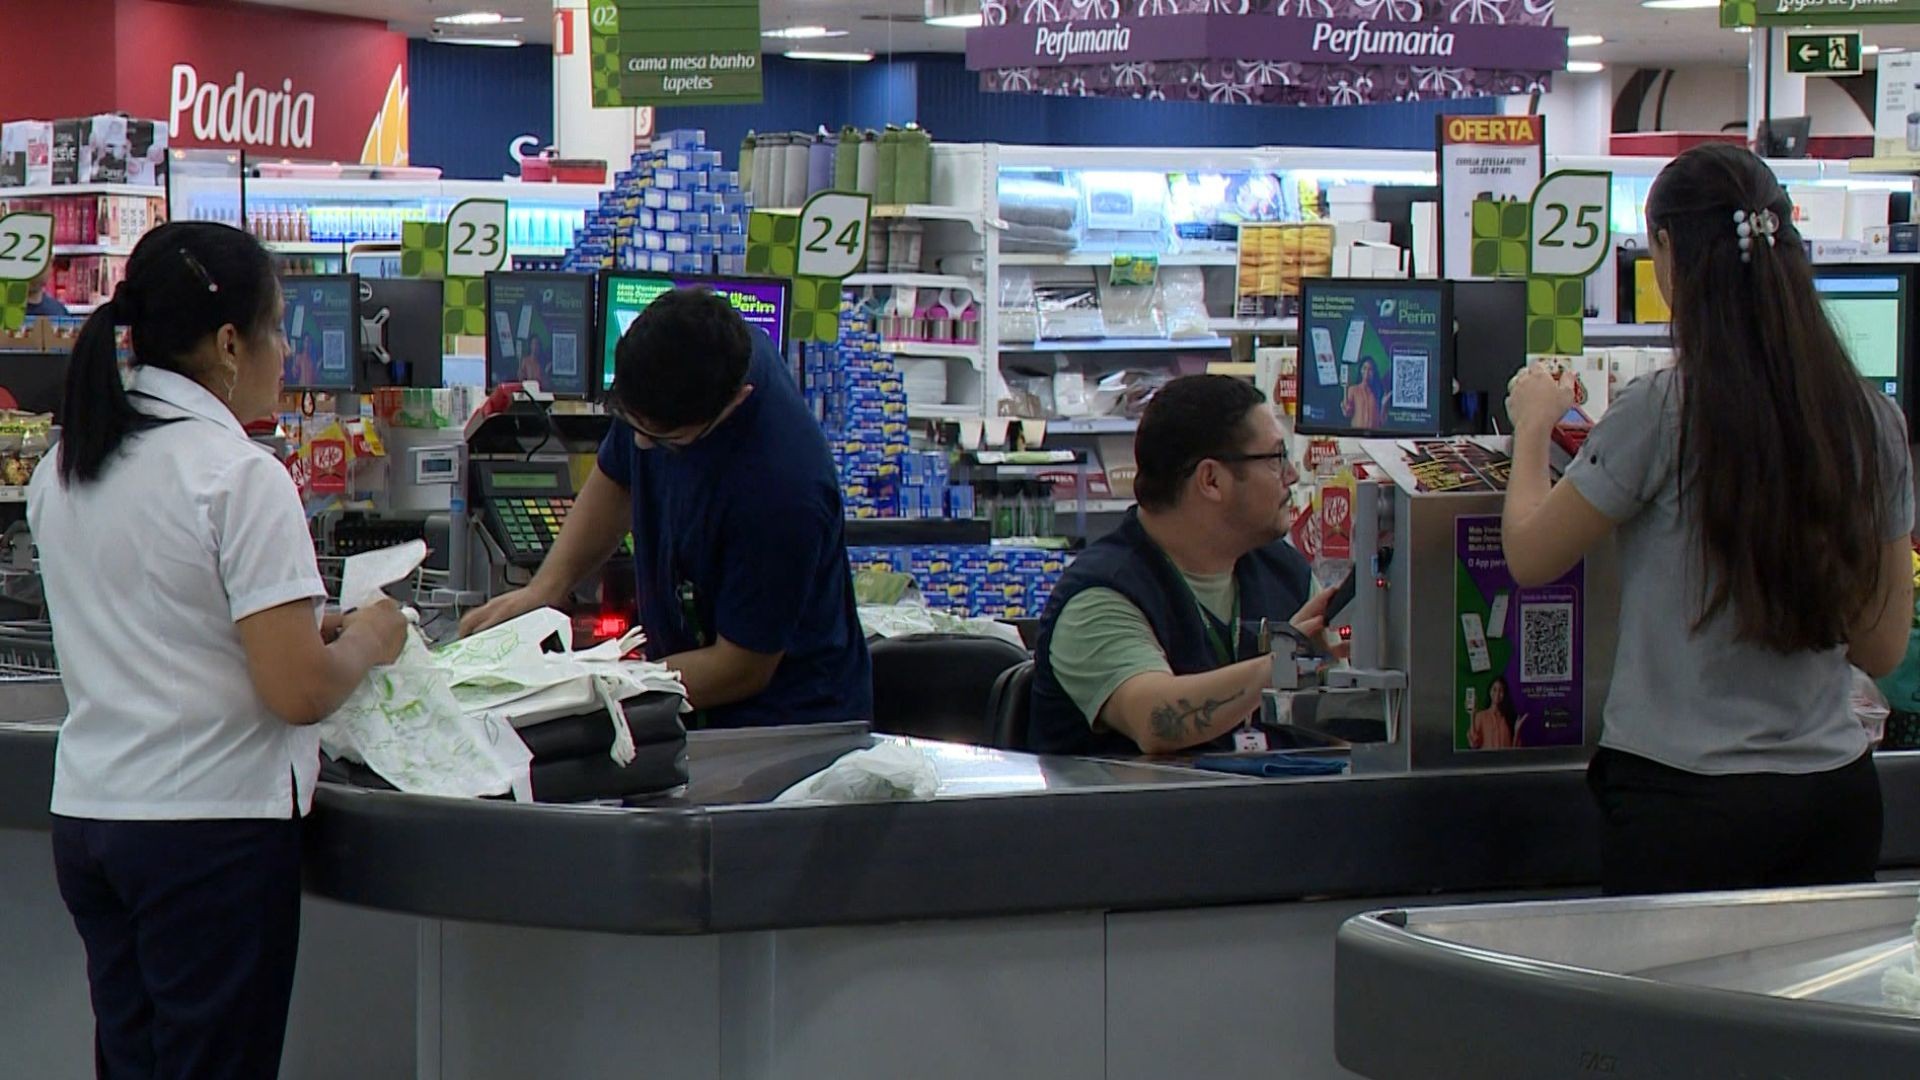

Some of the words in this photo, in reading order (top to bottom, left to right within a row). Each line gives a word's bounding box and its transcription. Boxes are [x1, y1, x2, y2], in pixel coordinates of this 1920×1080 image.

[593, 5, 617, 27] 02
[1035, 23, 1131, 62] Perfumaria
[1313, 22, 1454, 61] Perfumaria
[628, 57, 667, 71] cama
[670, 56, 706, 70] mesa
[709, 52, 755, 70] banho
[662, 74, 713, 92] tapetes
[169, 63, 315, 148] Padaria
[1448, 118, 1534, 142] OFERTA
[453, 222, 499, 256] 23
[804, 216, 860, 255] 24
[1538, 203, 1603, 249] 25
[1, 232, 46, 262] 22
[1399, 310, 1436, 324] Perim
[1311, 446, 1336, 456] STELLA
[1475, 557, 1489, 570] App
